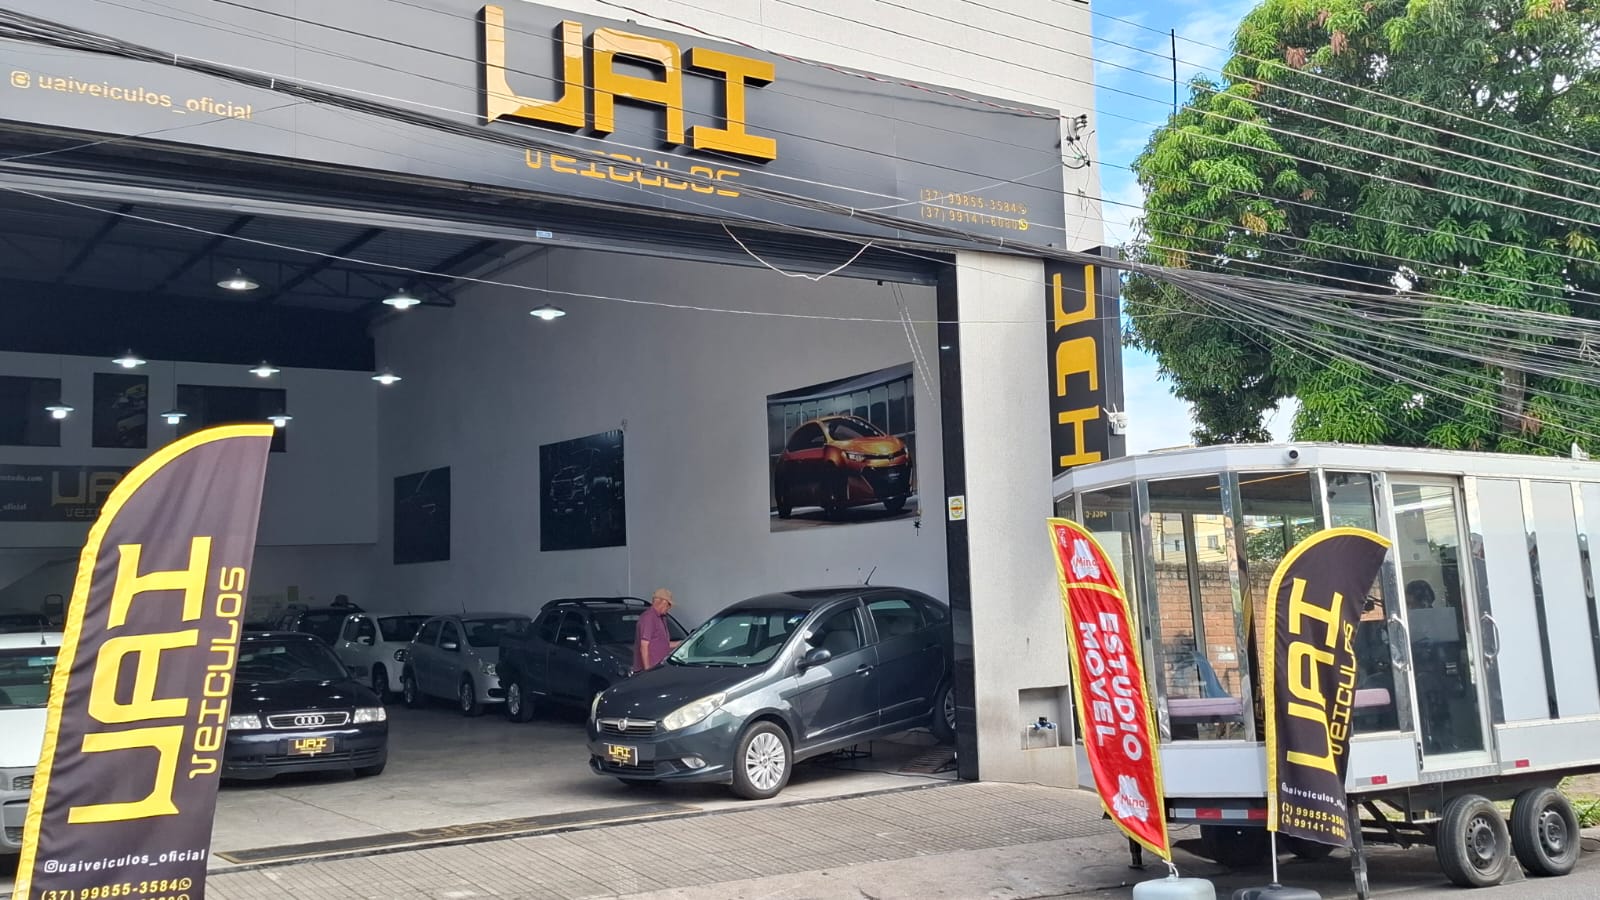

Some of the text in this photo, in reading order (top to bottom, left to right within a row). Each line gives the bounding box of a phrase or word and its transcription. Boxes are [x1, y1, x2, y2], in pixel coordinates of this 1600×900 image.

[38, 76, 252, 119] uaiveiculos_oficial
[481, 4, 777, 161] UAI
[920, 188, 1017, 213] (37) 99855-3584
[921, 206, 945, 222] (37)
[1053, 264, 1102, 467] UAI
[66, 536, 212, 825] UAI
[1080, 622, 1116, 747] MÓVEL
[1098, 612, 1143, 761] ESTÚDIO
[1286, 577, 1344, 776] UAI
[295, 737, 327, 749] UAI
[608, 744, 631, 758] UAI
[58, 849, 206, 873] uaiveiculos_oficial
[80, 878, 178, 900] 99855-3584
